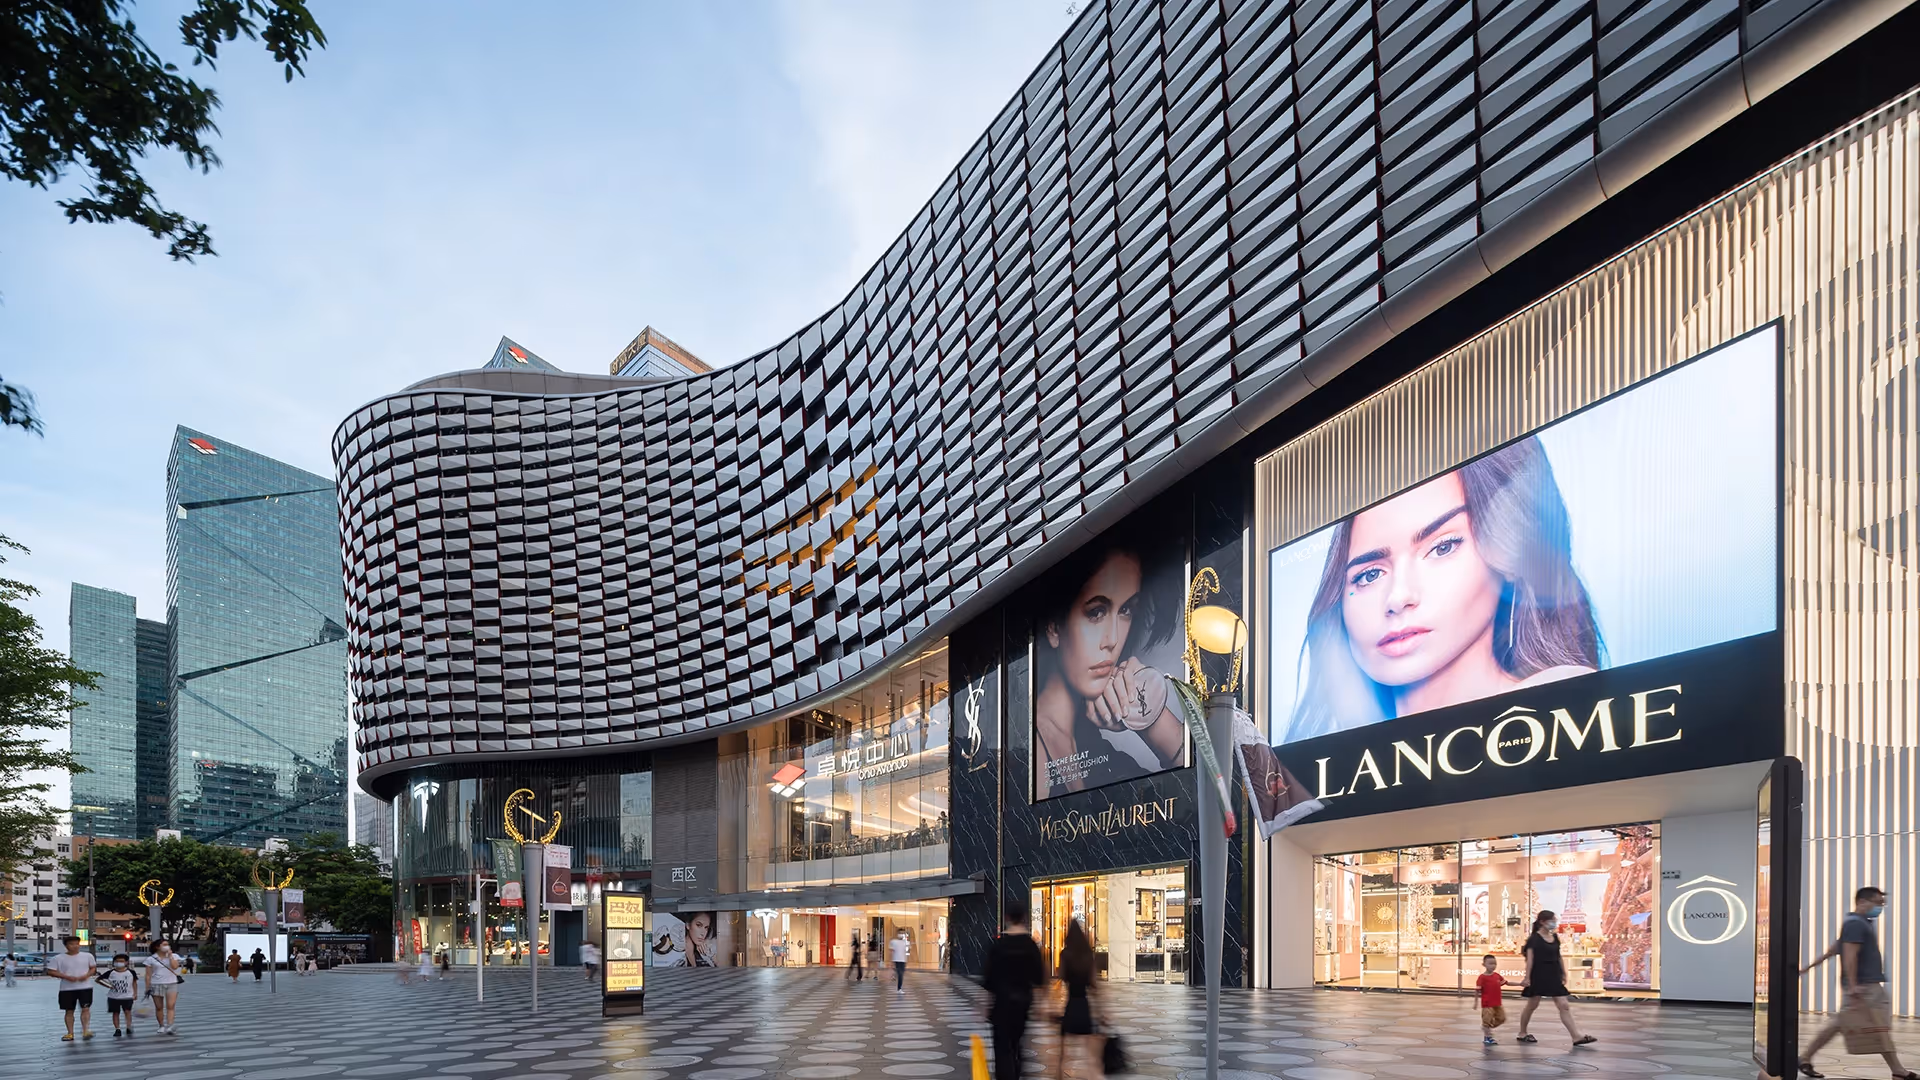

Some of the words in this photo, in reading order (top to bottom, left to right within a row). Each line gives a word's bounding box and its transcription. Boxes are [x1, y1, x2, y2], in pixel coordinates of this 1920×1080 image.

[1315, 684, 1683, 800] LANCÔME
[1498, 736, 1532, 749] PARIS
[816, 733, 909, 777] 卓悦中心
[1079, 754, 1109, 769] CUSHION
[1044, 757, 1069, 769] TOUCHE
[1104, 797, 1178, 837] LAURENT
[671, 866, 697, 883] 西区
[608, 900, 641, 915] 巴奴
[1684, 911, 1729, 920] LANCÔME
